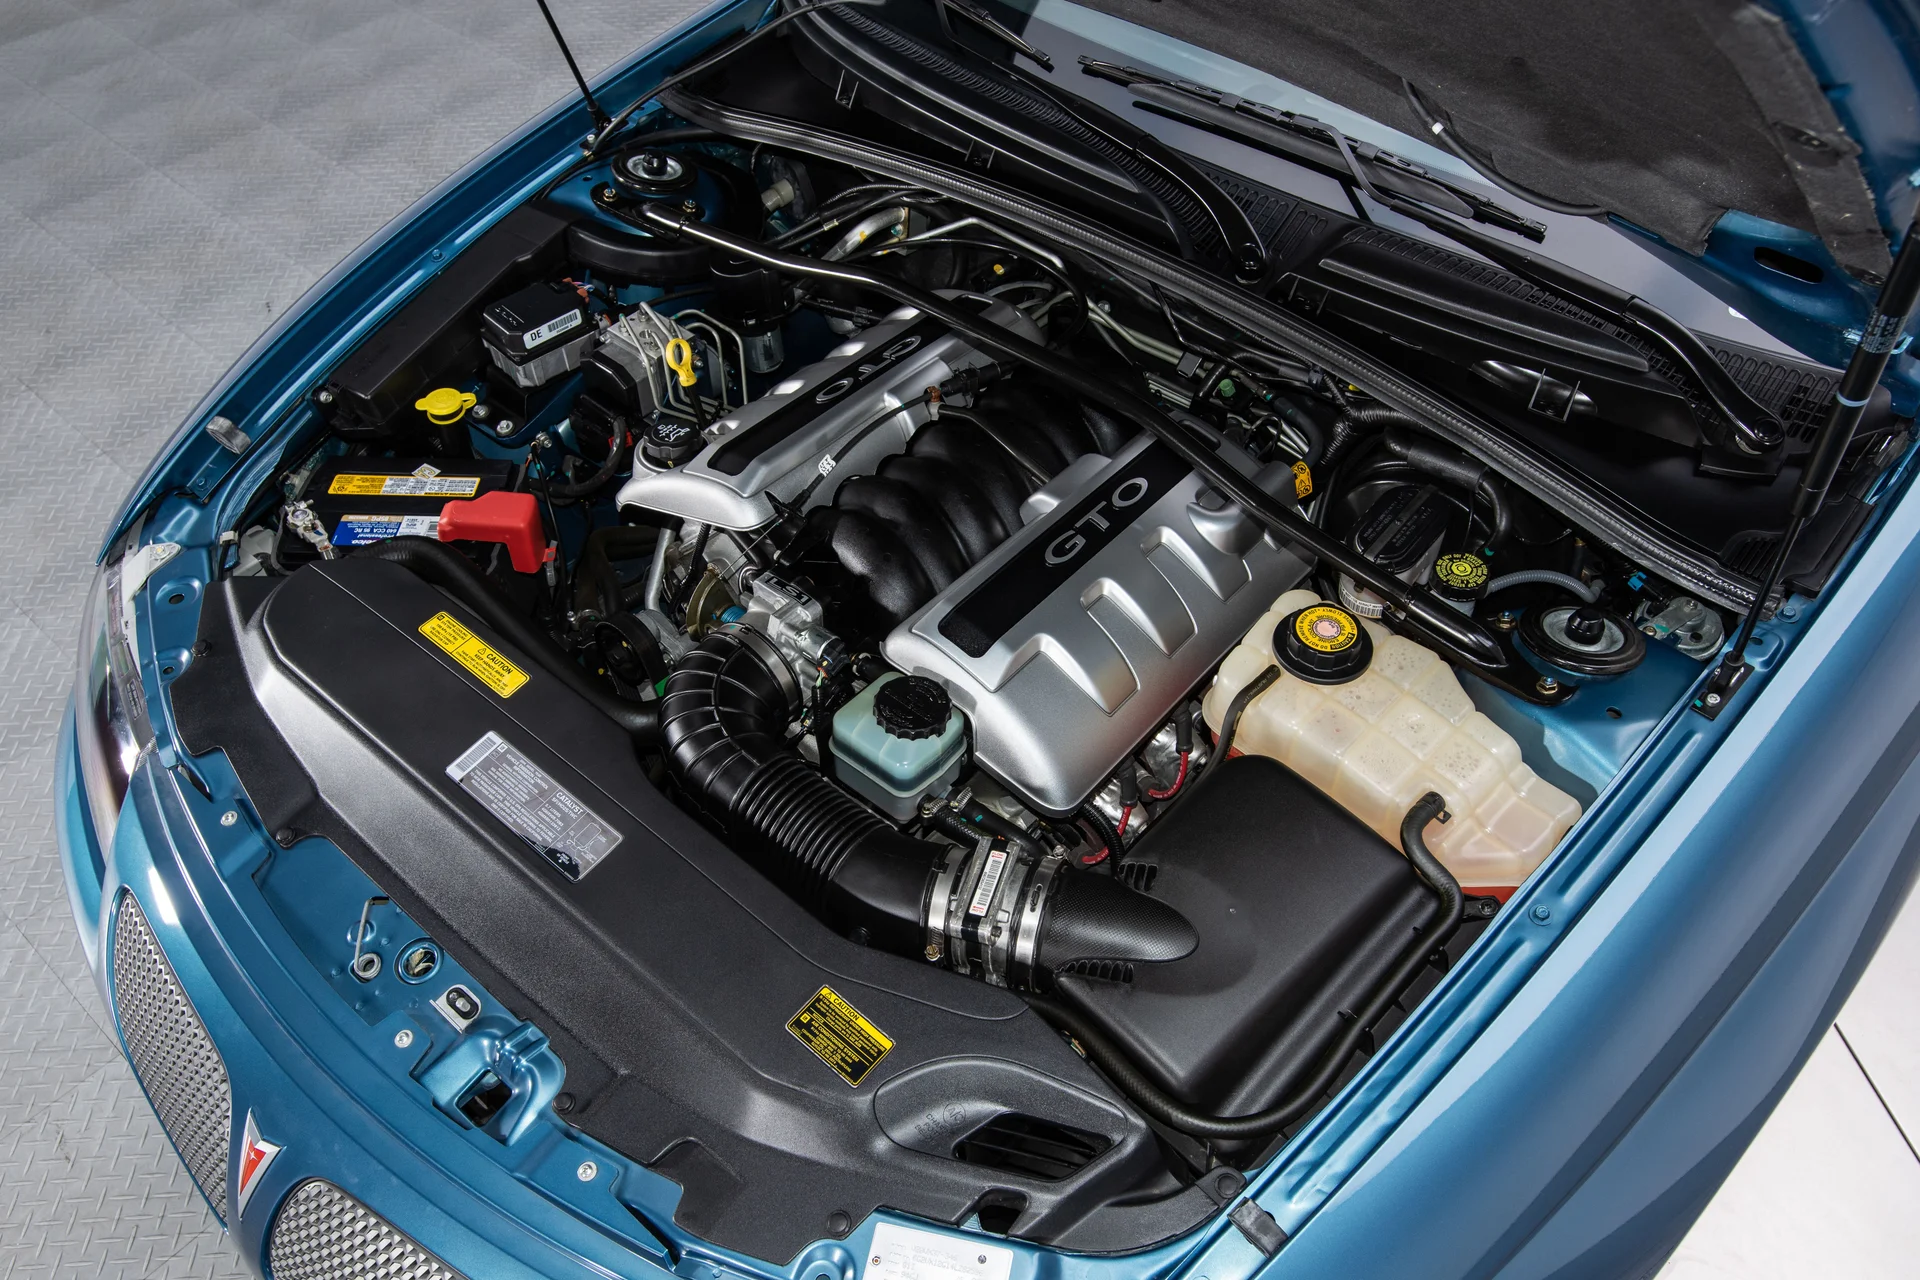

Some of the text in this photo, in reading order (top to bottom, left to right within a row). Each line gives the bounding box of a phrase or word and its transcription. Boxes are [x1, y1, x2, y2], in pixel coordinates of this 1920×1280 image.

[530, 329, 542, 341] DE
[1045, 477, 1148, 566] GTO
[770, 577, 809, 602] LS1
[1299, 624, 1309, 642] REMOVE
[1309, 640, 1319, 648] NOT
[1332, 637, 1351, 649] CAUTION
[474, 653, 483, 661] KEEP
[482, 660, 495, 670] HANDS
[485, 652, 513, 674] CAUTION
[533, 776, 549, 789] CONTROL
[549, 807, 561, 817] LITERS
[555, 791, 583, 815] CATALYST
[832, 997, 859, 1021] CAUTION
[817, 1025, 844, 1049] CONDITIONING
[842, 1047, 859, 1062] SYSTEM
